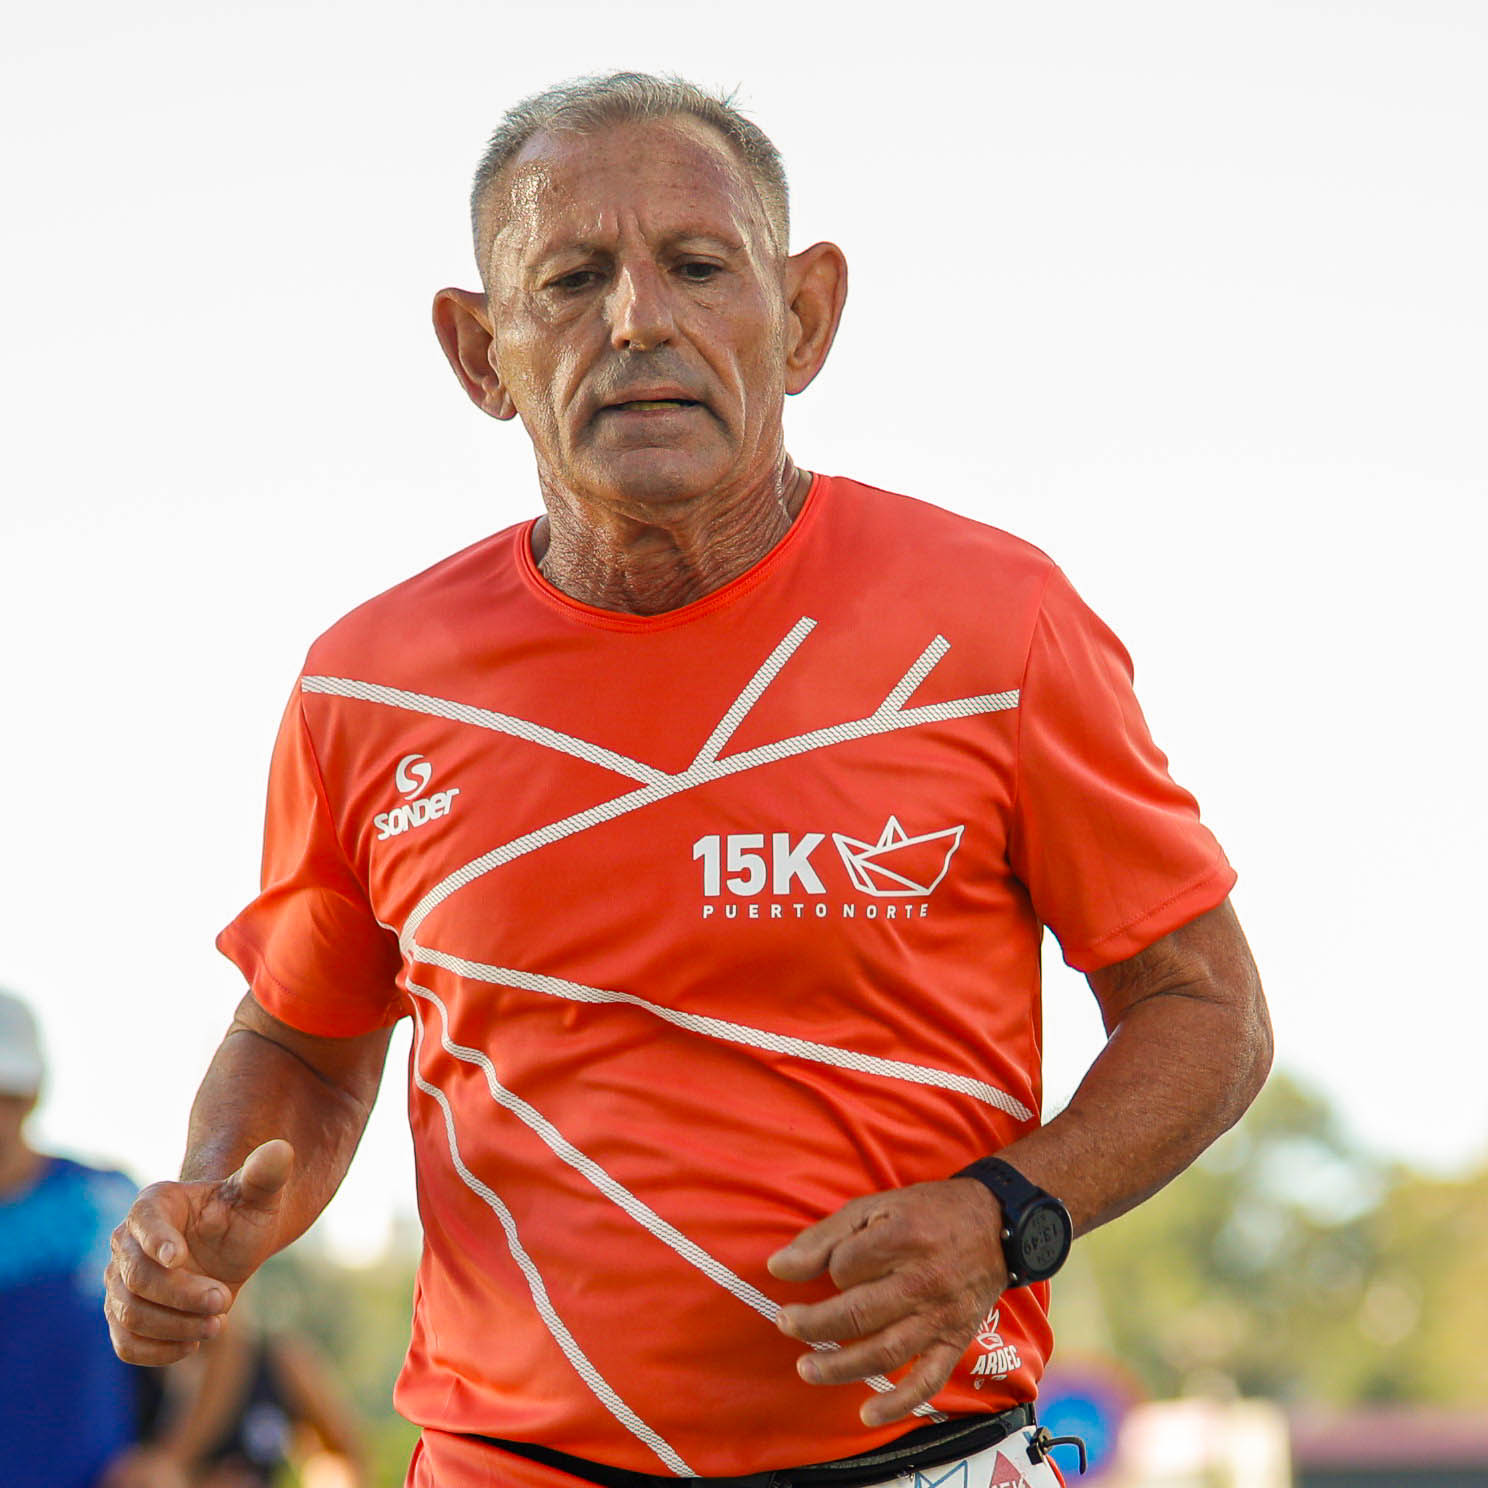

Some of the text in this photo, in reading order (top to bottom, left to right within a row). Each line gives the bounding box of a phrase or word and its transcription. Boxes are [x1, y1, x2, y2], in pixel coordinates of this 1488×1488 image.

[692, 832, 827, 897] 15K
[703, 903, 929, 919] PUERTO NORTE
